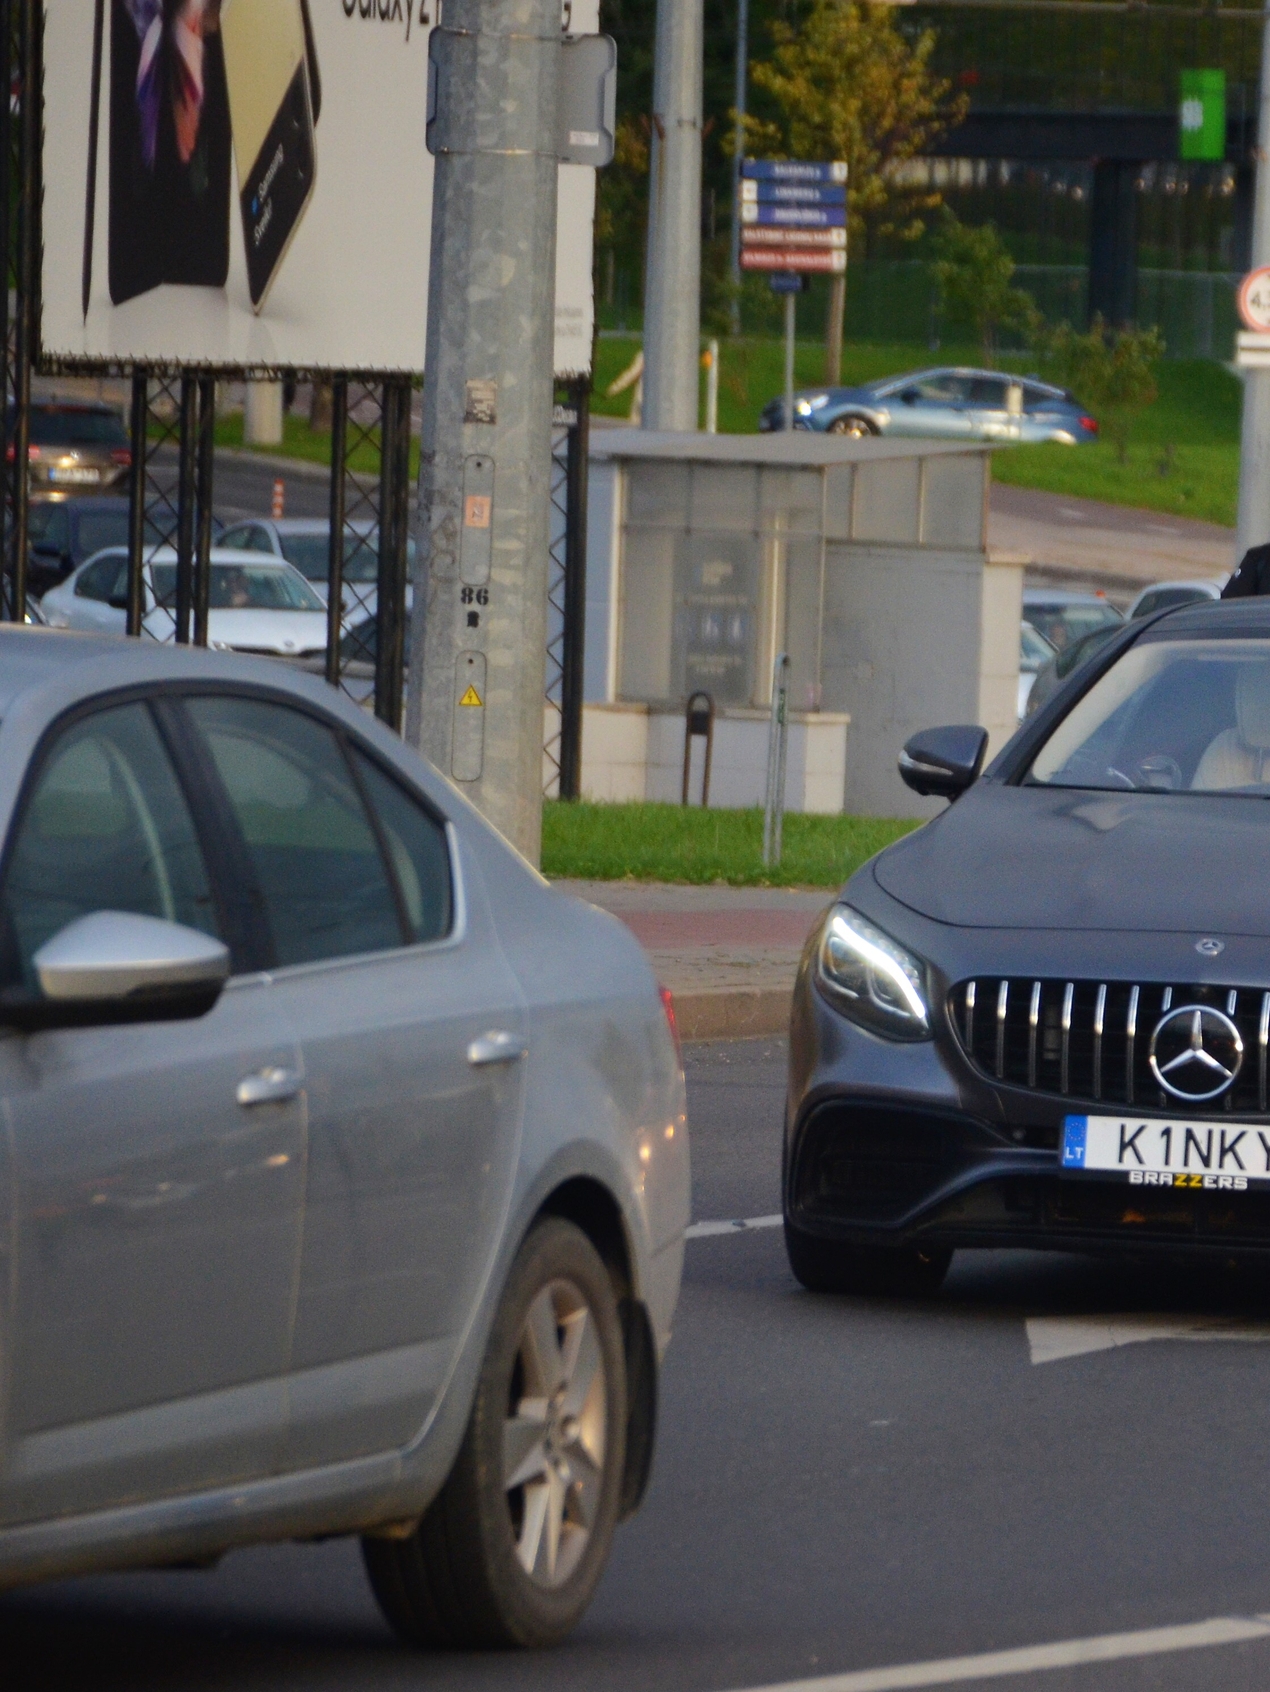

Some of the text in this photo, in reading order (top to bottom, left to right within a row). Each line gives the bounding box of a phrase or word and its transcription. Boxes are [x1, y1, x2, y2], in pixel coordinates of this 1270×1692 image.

[461, 587, 489, 606] 86
[1065, 1146, 1084, 1160] LT
[1128, 1170, 1248, 1191] BRAZZERS
